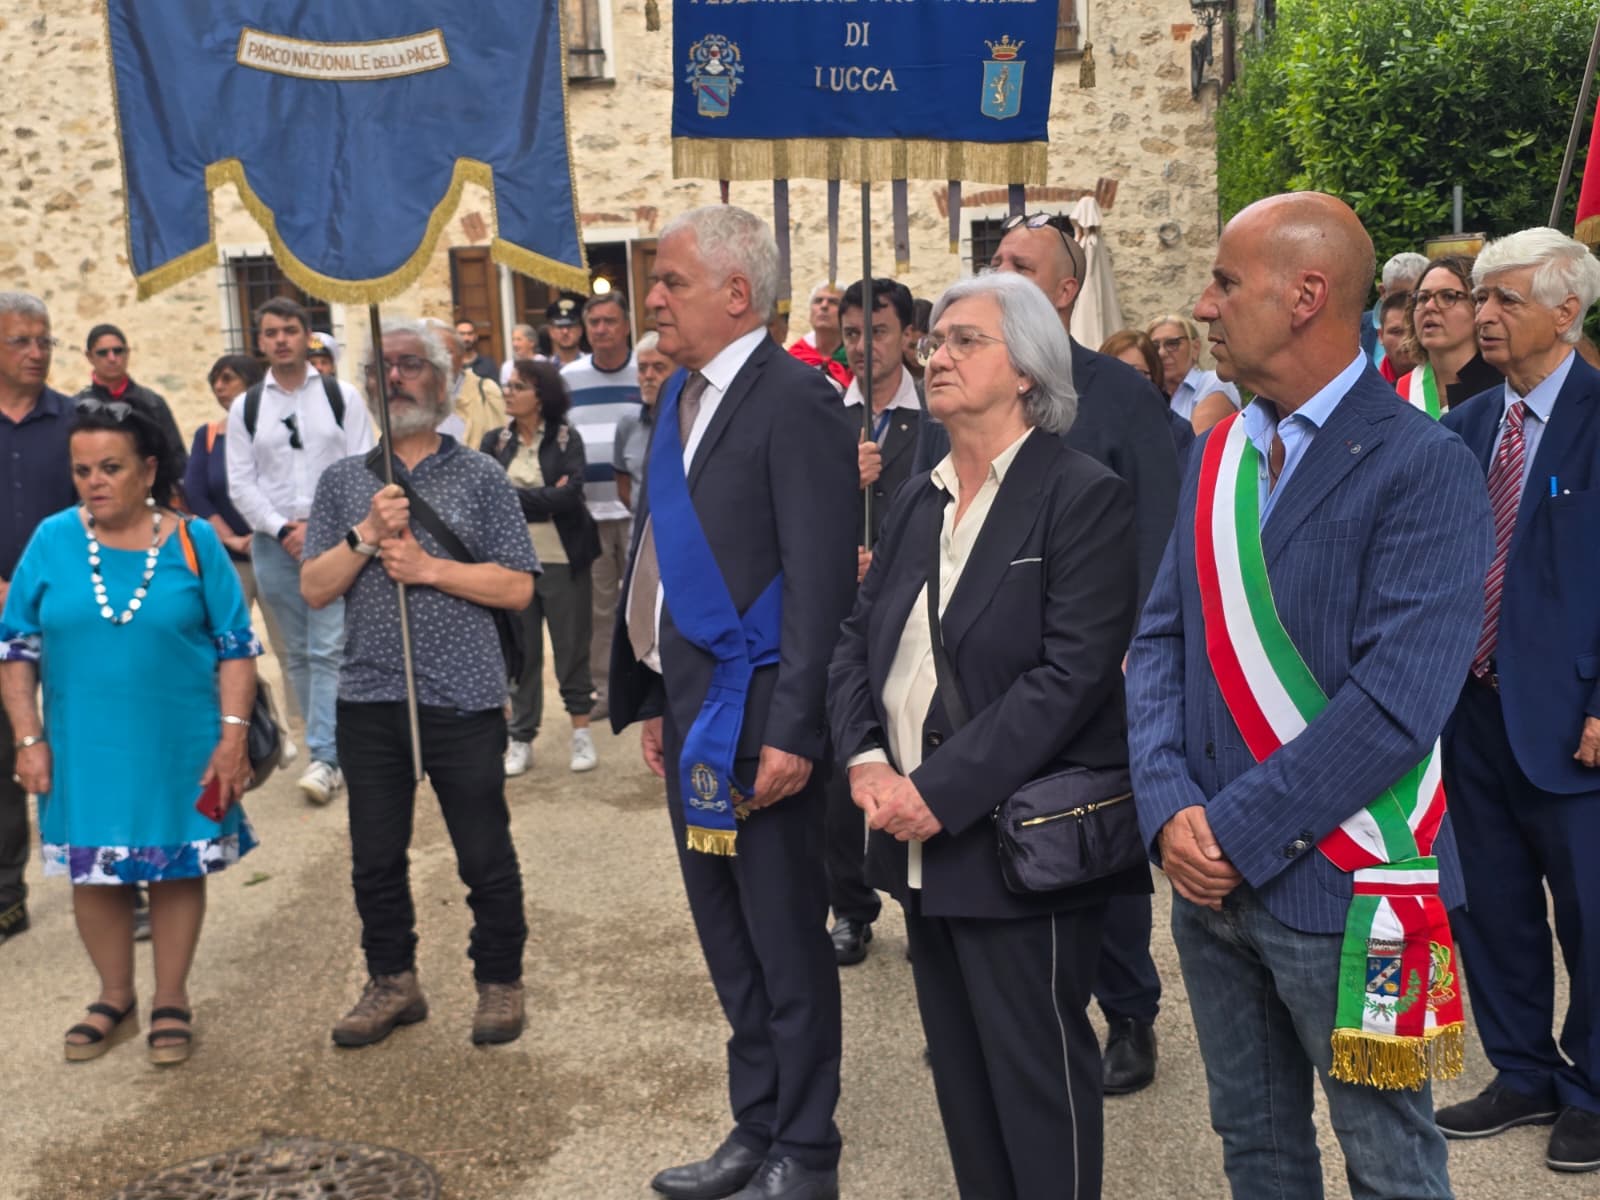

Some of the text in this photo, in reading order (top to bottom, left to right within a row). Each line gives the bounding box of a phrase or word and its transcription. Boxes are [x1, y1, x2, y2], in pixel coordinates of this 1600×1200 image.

[844, 21, 870, 46] DI
[248, 41, 440, 71] PARCO NAZIONALE DELLA PACE
[814, 66, 899, 92] LUCCA
